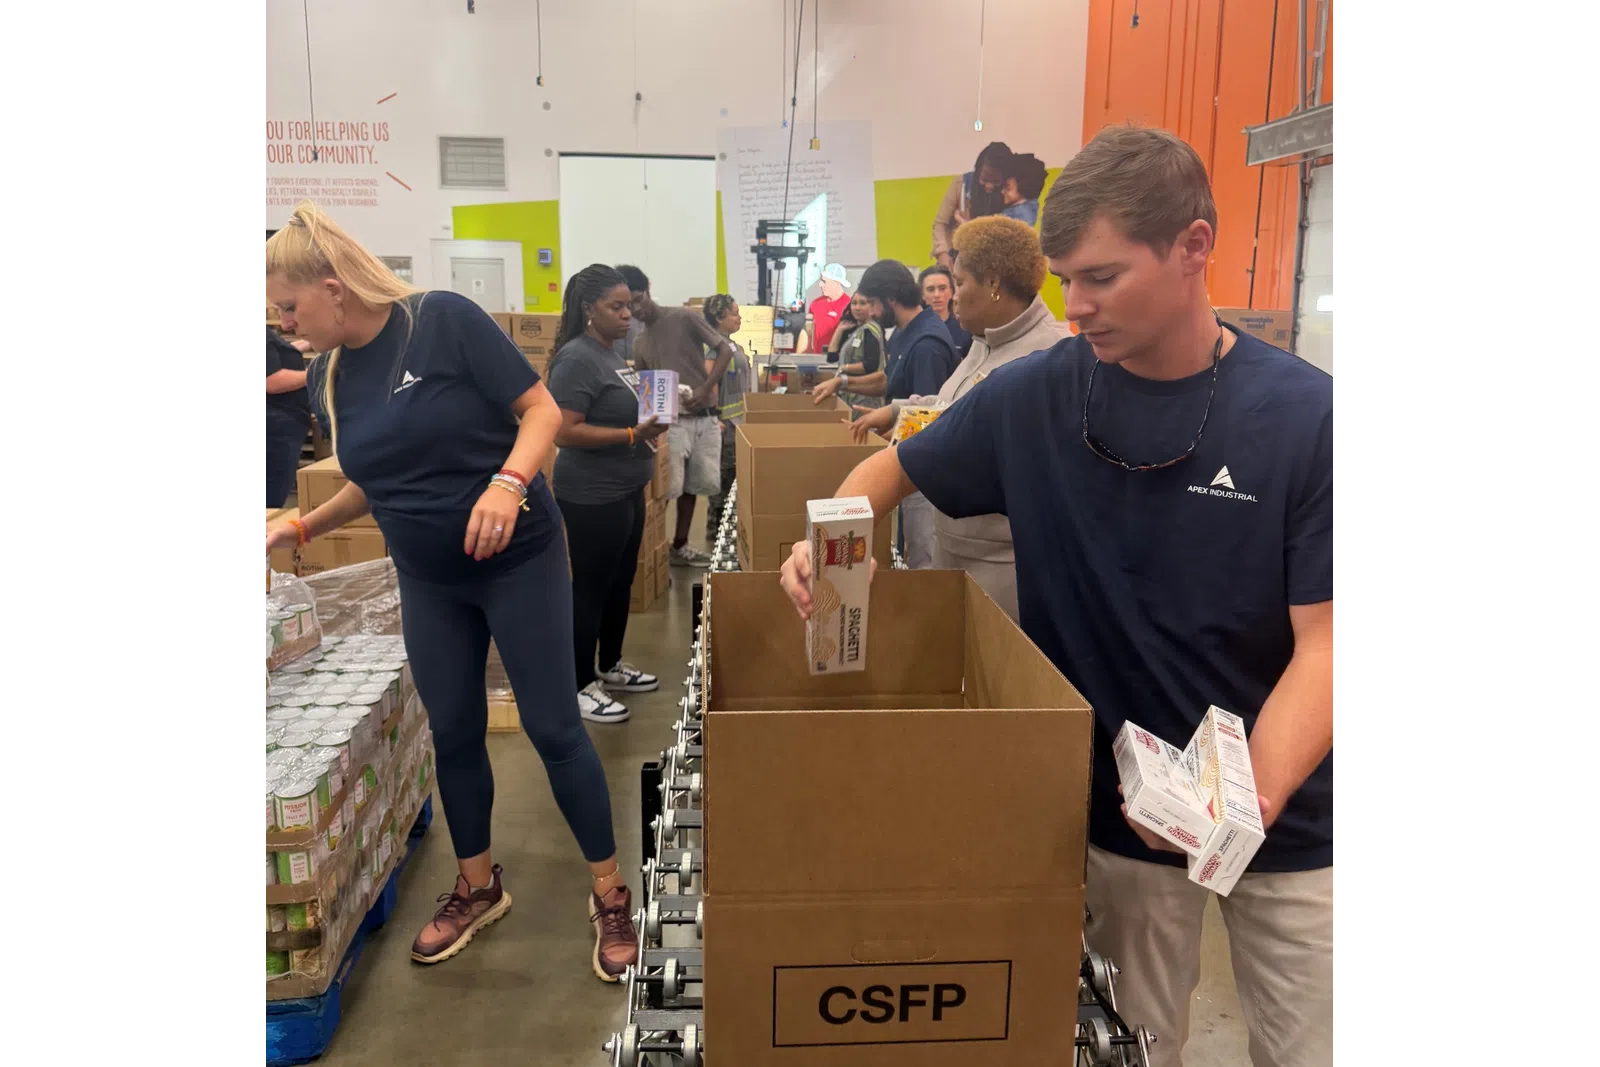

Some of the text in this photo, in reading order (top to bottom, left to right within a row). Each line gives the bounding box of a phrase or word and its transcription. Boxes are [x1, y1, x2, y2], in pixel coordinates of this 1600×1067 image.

[288, 121, 312, 141] FOR
[315, 121, 369, 141] HELPING
[373, 122, 389, 141] US
[267, 144, 378, 164] OUR COMMUNITY.
[657, 378, 666, 412] ROTINI
[1187, 485, 1258, 502] APEX INDUSTRIAL
[847, 607, 861, 662] SPAGHETTI
[284, 802, 307, 810] MISSION
[1138, 809, 1164, 827] SPAGHETTI
[1166, 825, 1201, 850] GIOVANNI
[1219, 829, 1236, 852] SPAGHETTI
[1199, 853, 1220, 883] GIOVANNI
[1207, 861, 1222, 881] PRIMO
[818, 983, 966, 1025] CSFP
